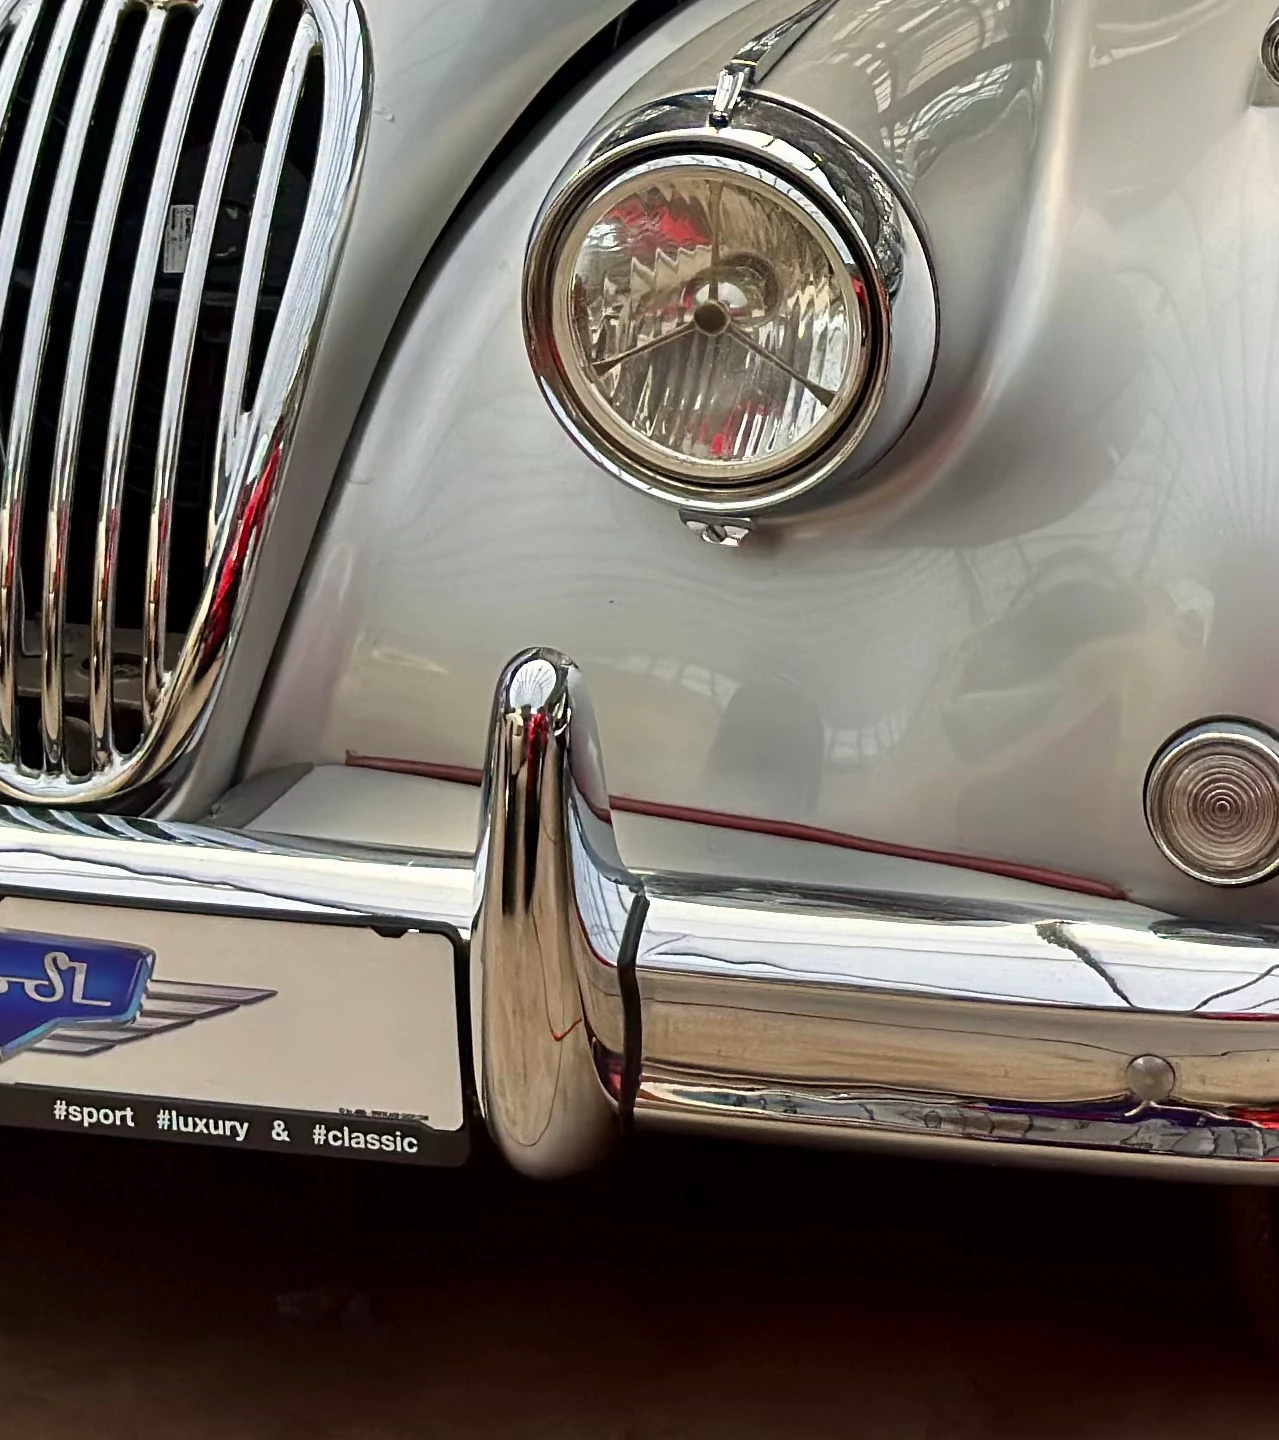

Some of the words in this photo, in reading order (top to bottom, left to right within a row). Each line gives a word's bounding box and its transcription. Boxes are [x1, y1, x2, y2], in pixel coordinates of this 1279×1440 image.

[53, 1099, 135, 1128] #sport
[157, 1108, 249, 1142] #luxury
[271, 1120, 291, 1142] &
[312, 1123, 419, 1154] #classic
